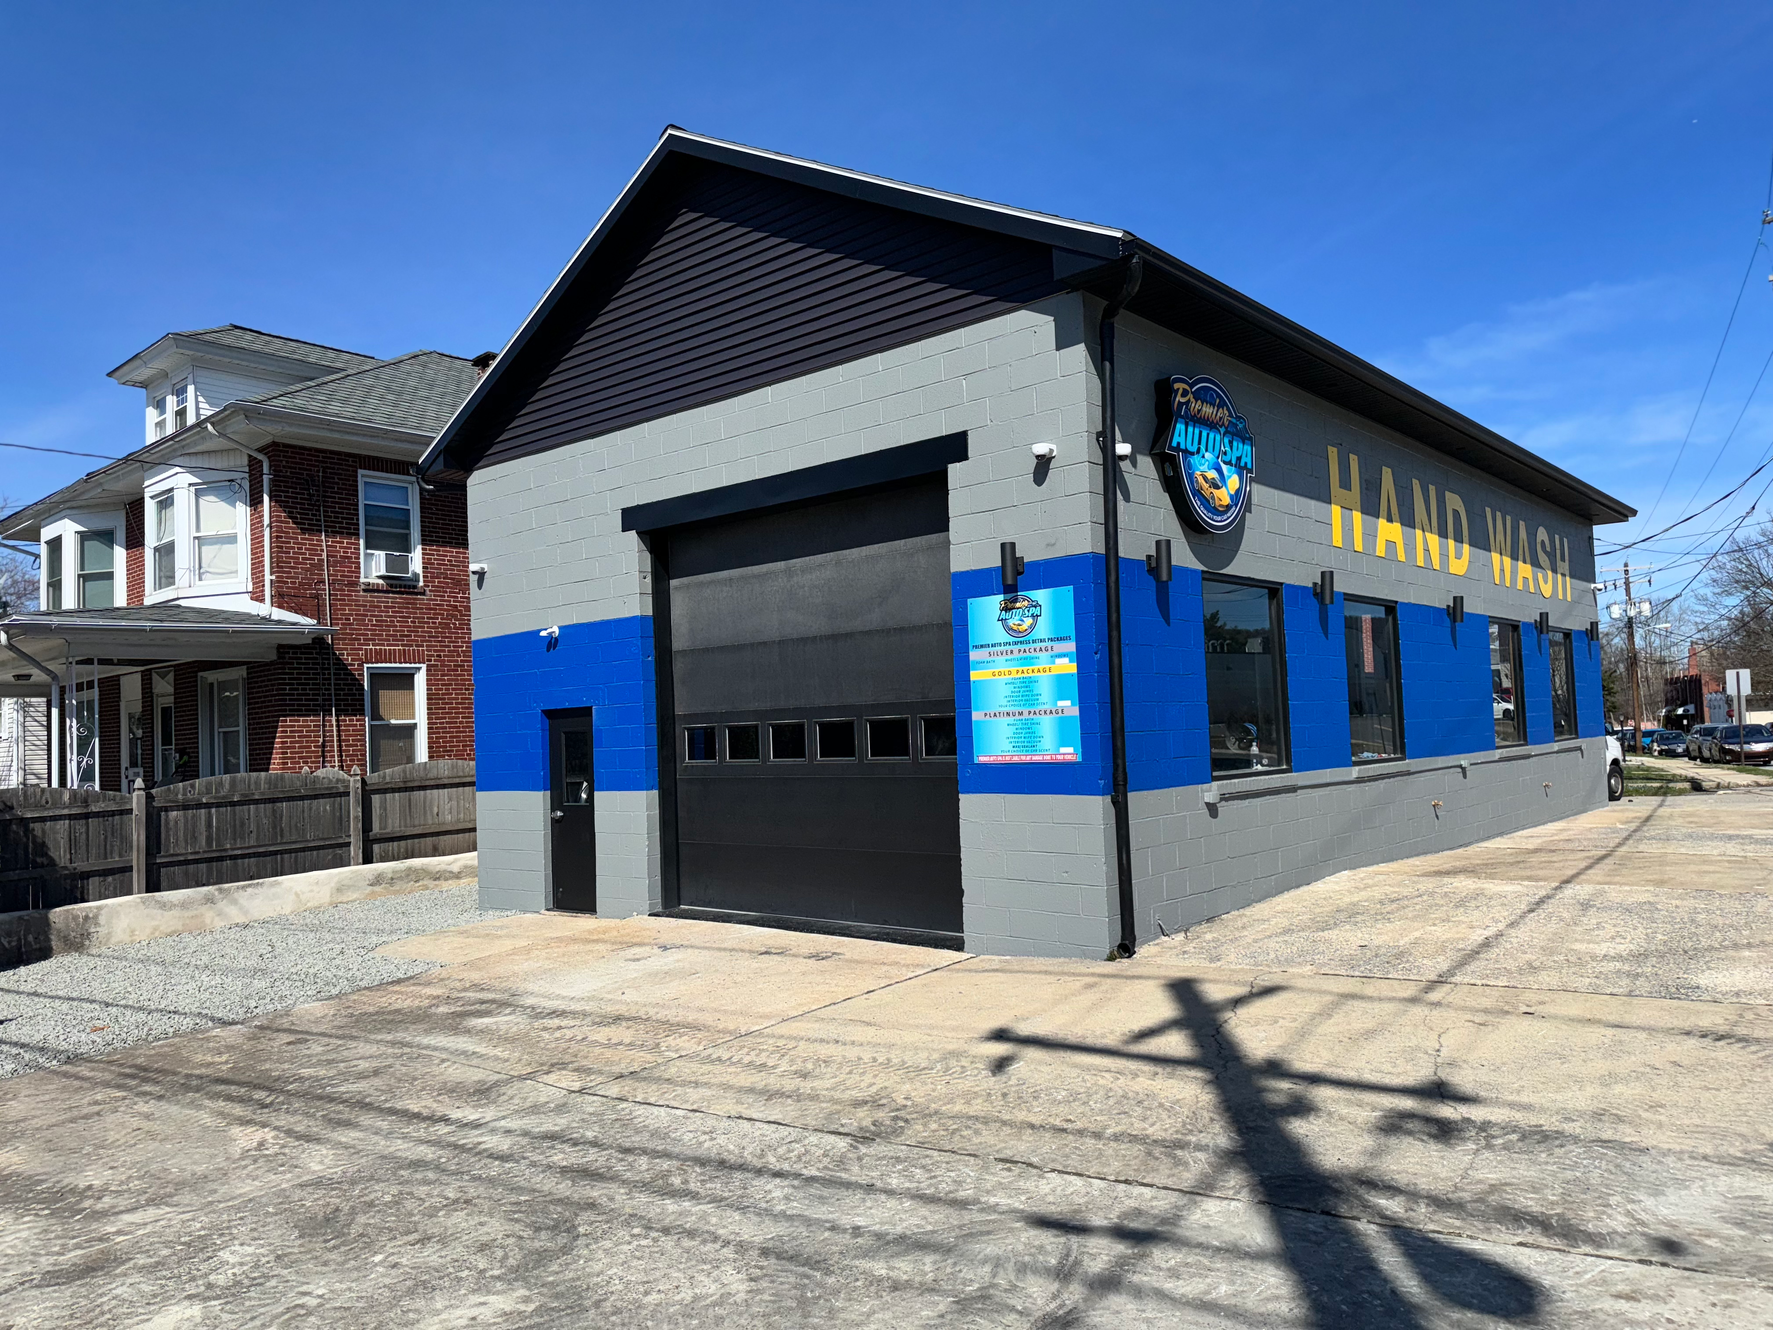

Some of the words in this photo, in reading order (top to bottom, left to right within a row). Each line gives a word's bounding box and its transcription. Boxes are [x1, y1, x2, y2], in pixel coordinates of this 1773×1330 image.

[1173, 382, 1230, 427] Premier
[1171, 418, 1221, 458] AUTO
[1222, 433, 1252, 469] SPA
[1327, 445, 1470, 576] HAND
[1485, 506, 1571, 602] WASH
[1000, 609, 1022, 620] AUTO
[1023, 606, 1041, 617] SPA
[1047, 635, 1072, 643] PACKAGES
[988, 649, 1014, 657] SILVER
[1018, 646, 1054, 655] PACKAGE
[1016, 667, 1052, 675] PACKAGE
[1028, 708, 1065, 716] PACKAGE
